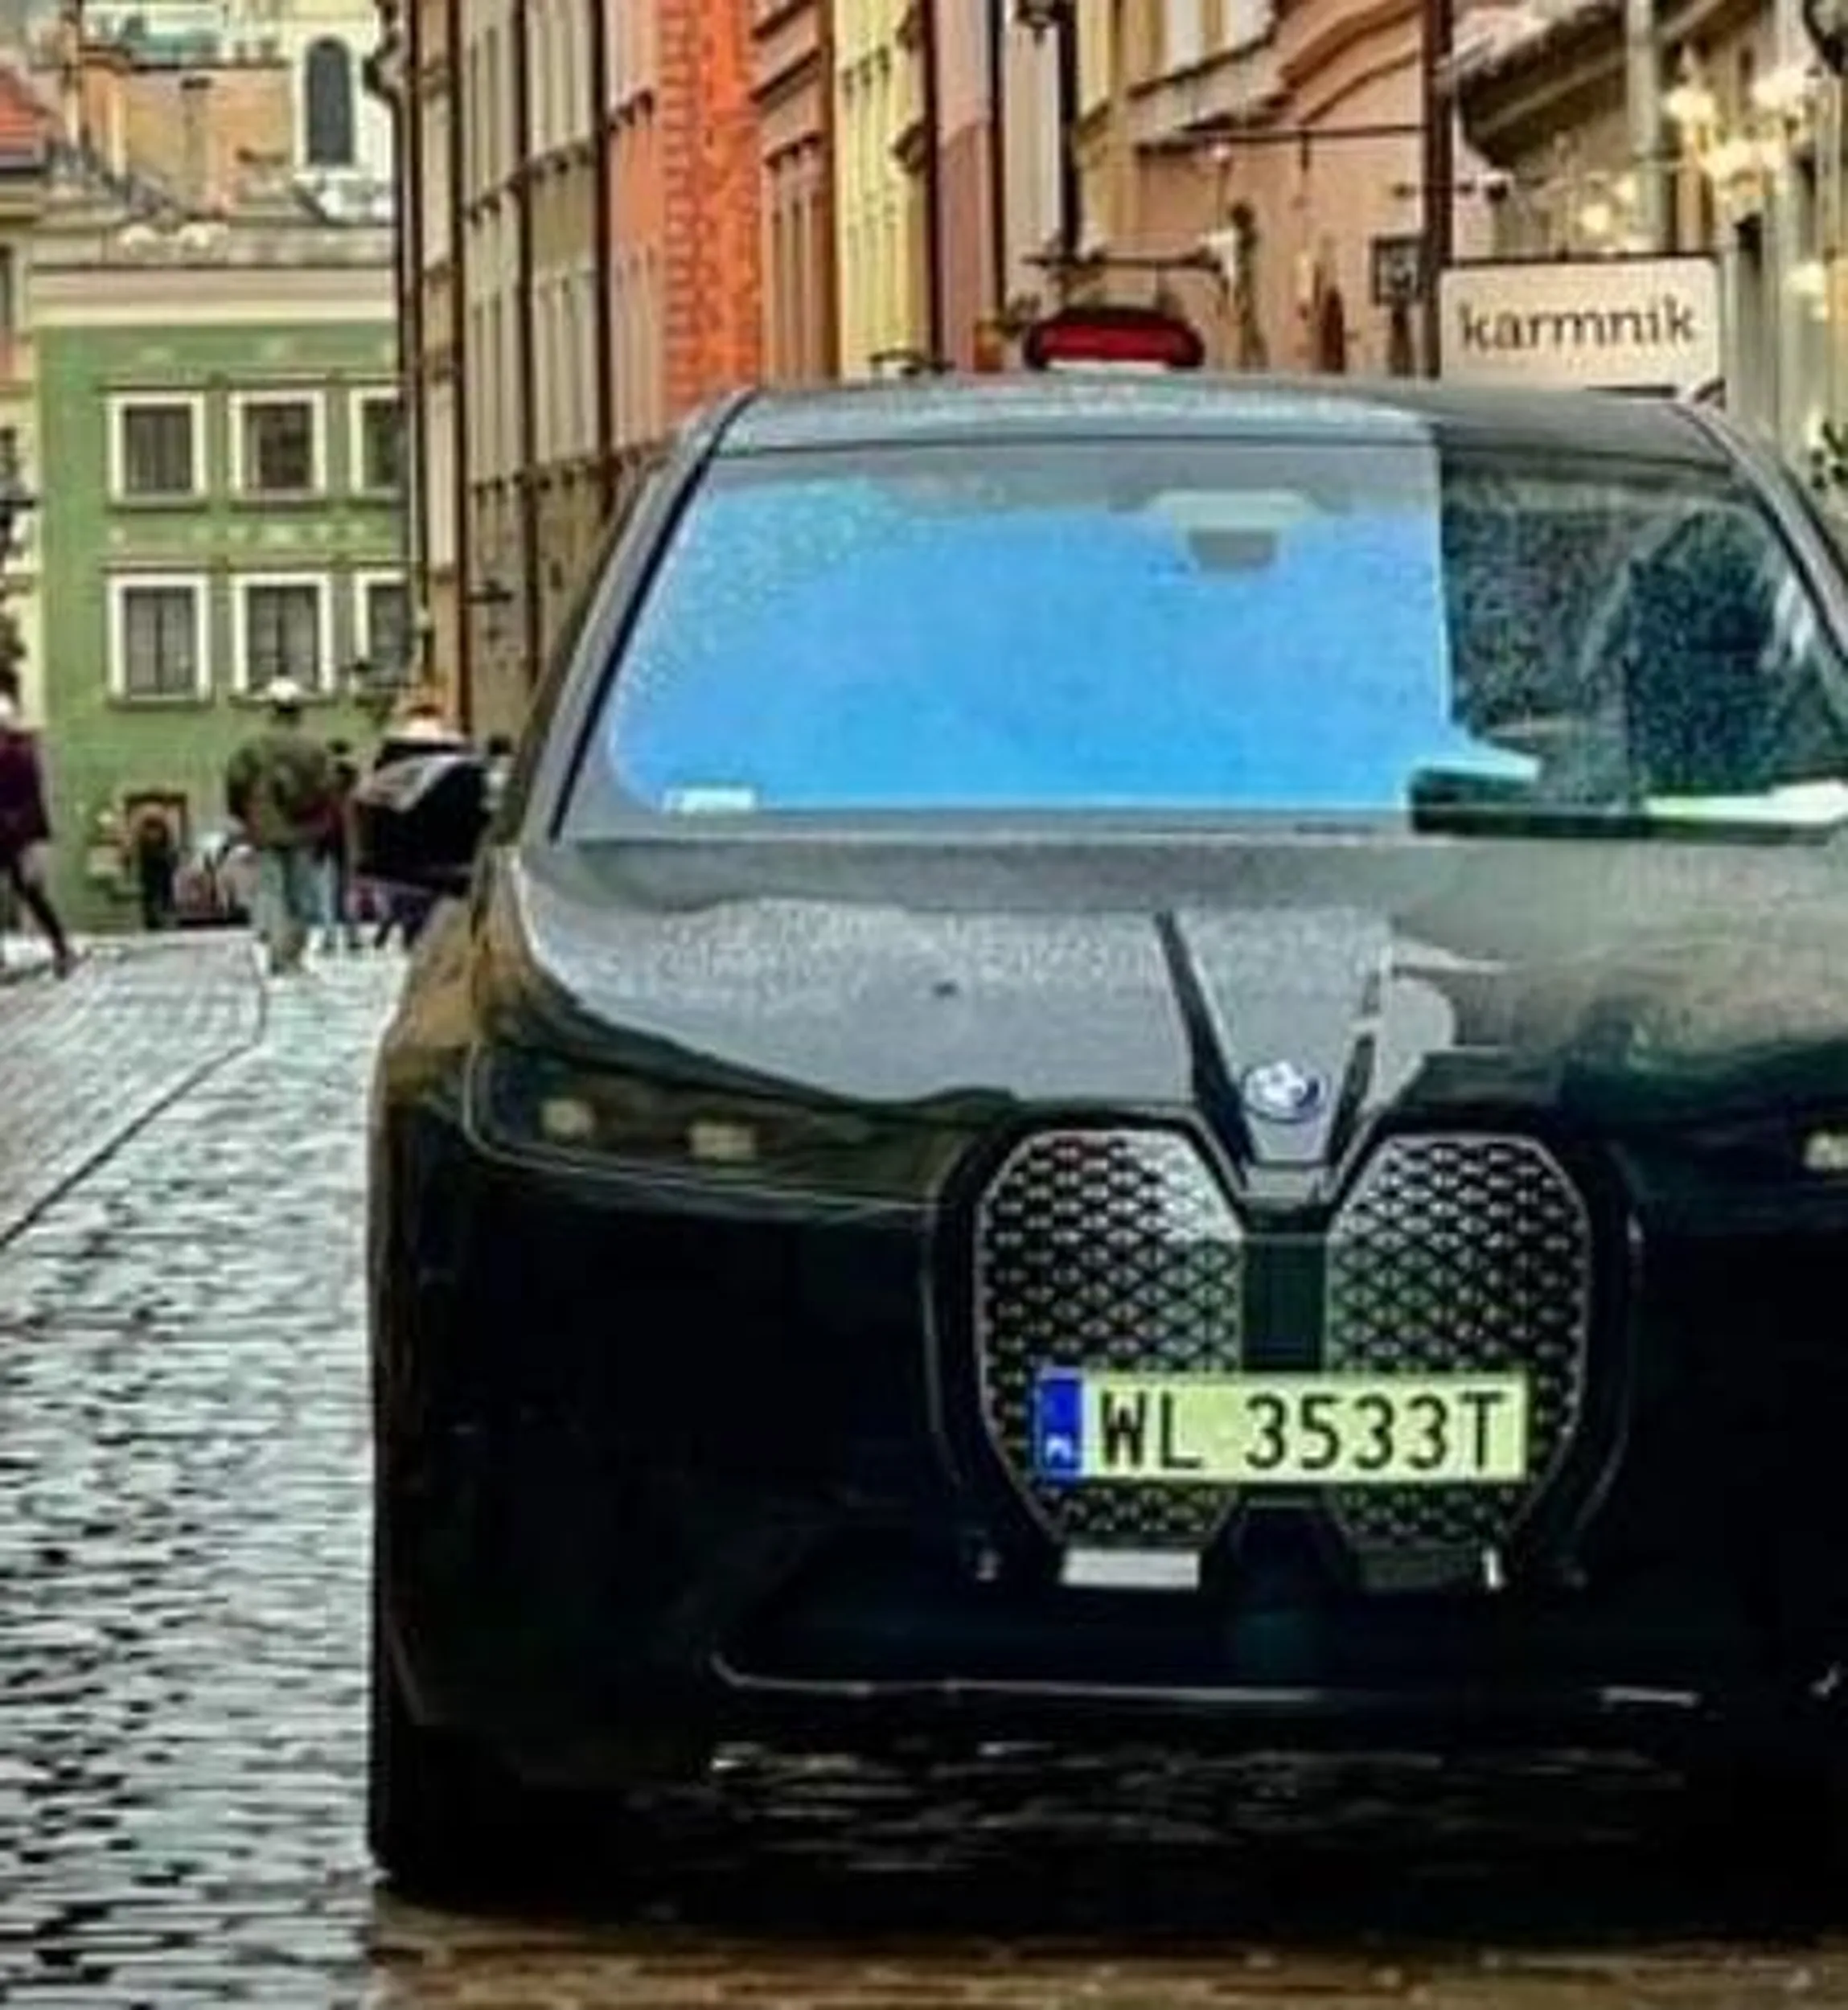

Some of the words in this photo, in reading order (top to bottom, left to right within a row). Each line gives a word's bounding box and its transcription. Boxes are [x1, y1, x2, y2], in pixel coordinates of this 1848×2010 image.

[1459, 295, 1695, 350] karmnik
[1100, 1390, 1202, 1469] WL
[1246, 1391, 1509, 1471] 3533T
